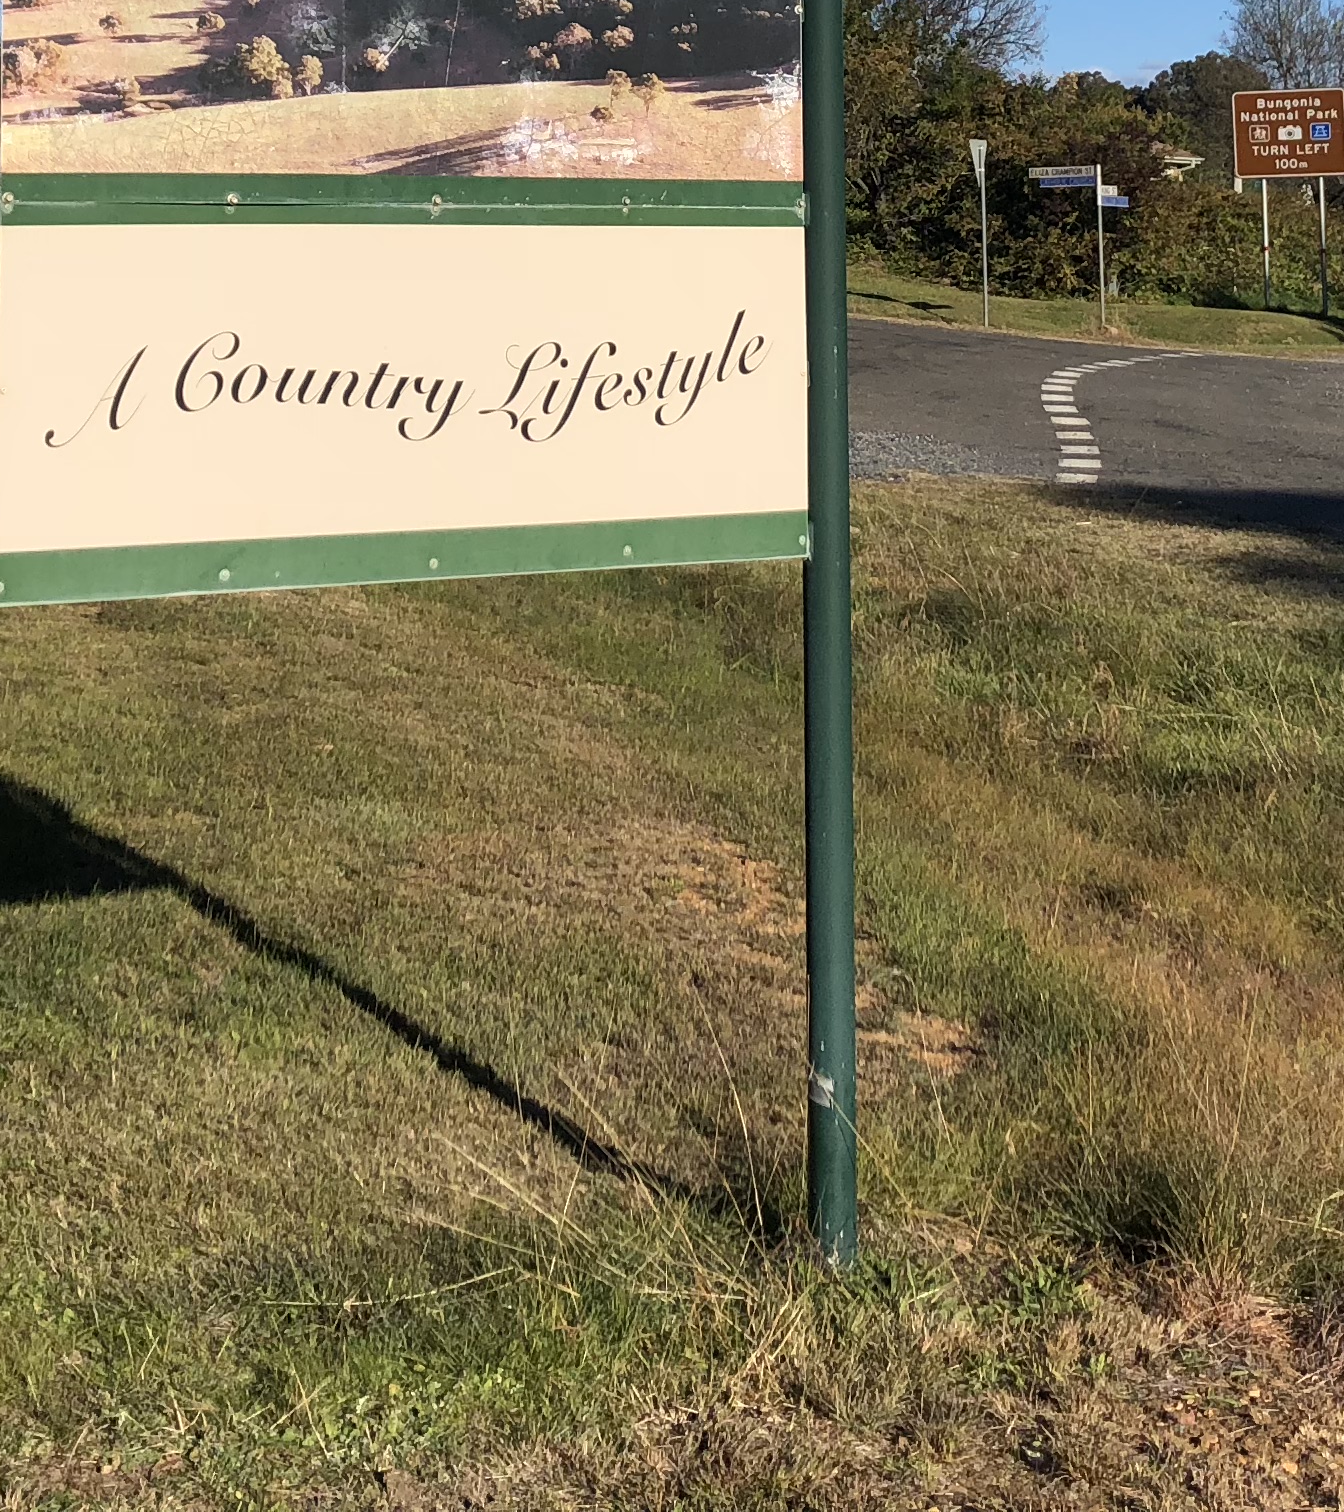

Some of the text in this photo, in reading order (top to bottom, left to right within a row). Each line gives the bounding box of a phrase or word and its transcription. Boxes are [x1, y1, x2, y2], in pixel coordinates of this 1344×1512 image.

[1256, 96, 1321, 111] Bungonia
[1240, 108, 1338, 122] National Park
[1252, 143, 1330, 156] TURN LEFT
[1274, 158, 1309, 170] 100m
[44, 308, 774, 448] A Country Lifestyle
